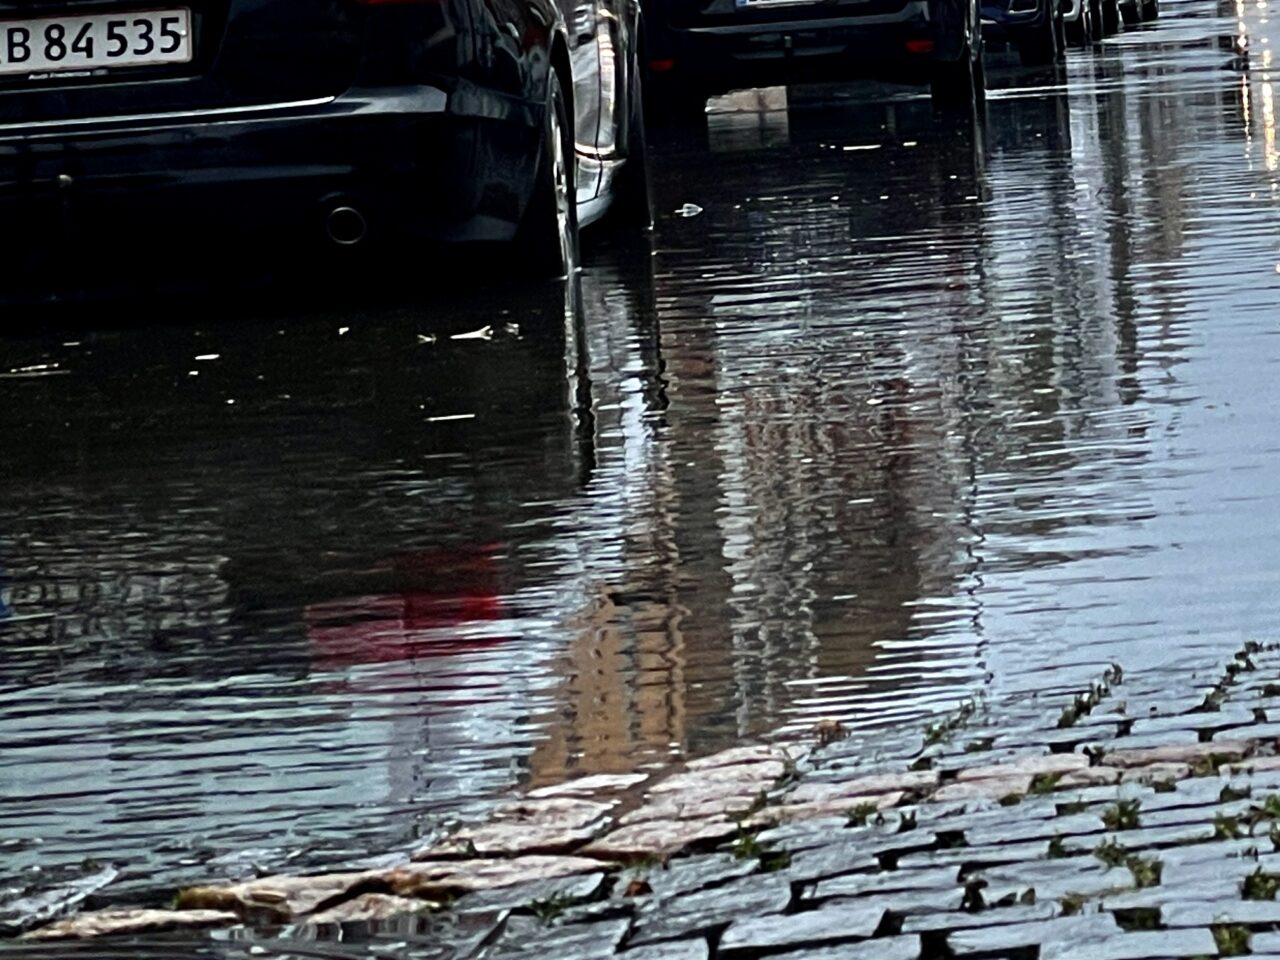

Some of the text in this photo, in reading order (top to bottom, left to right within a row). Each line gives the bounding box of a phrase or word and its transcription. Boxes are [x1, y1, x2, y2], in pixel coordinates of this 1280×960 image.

[0, 16, 182, 64] B 84 535
